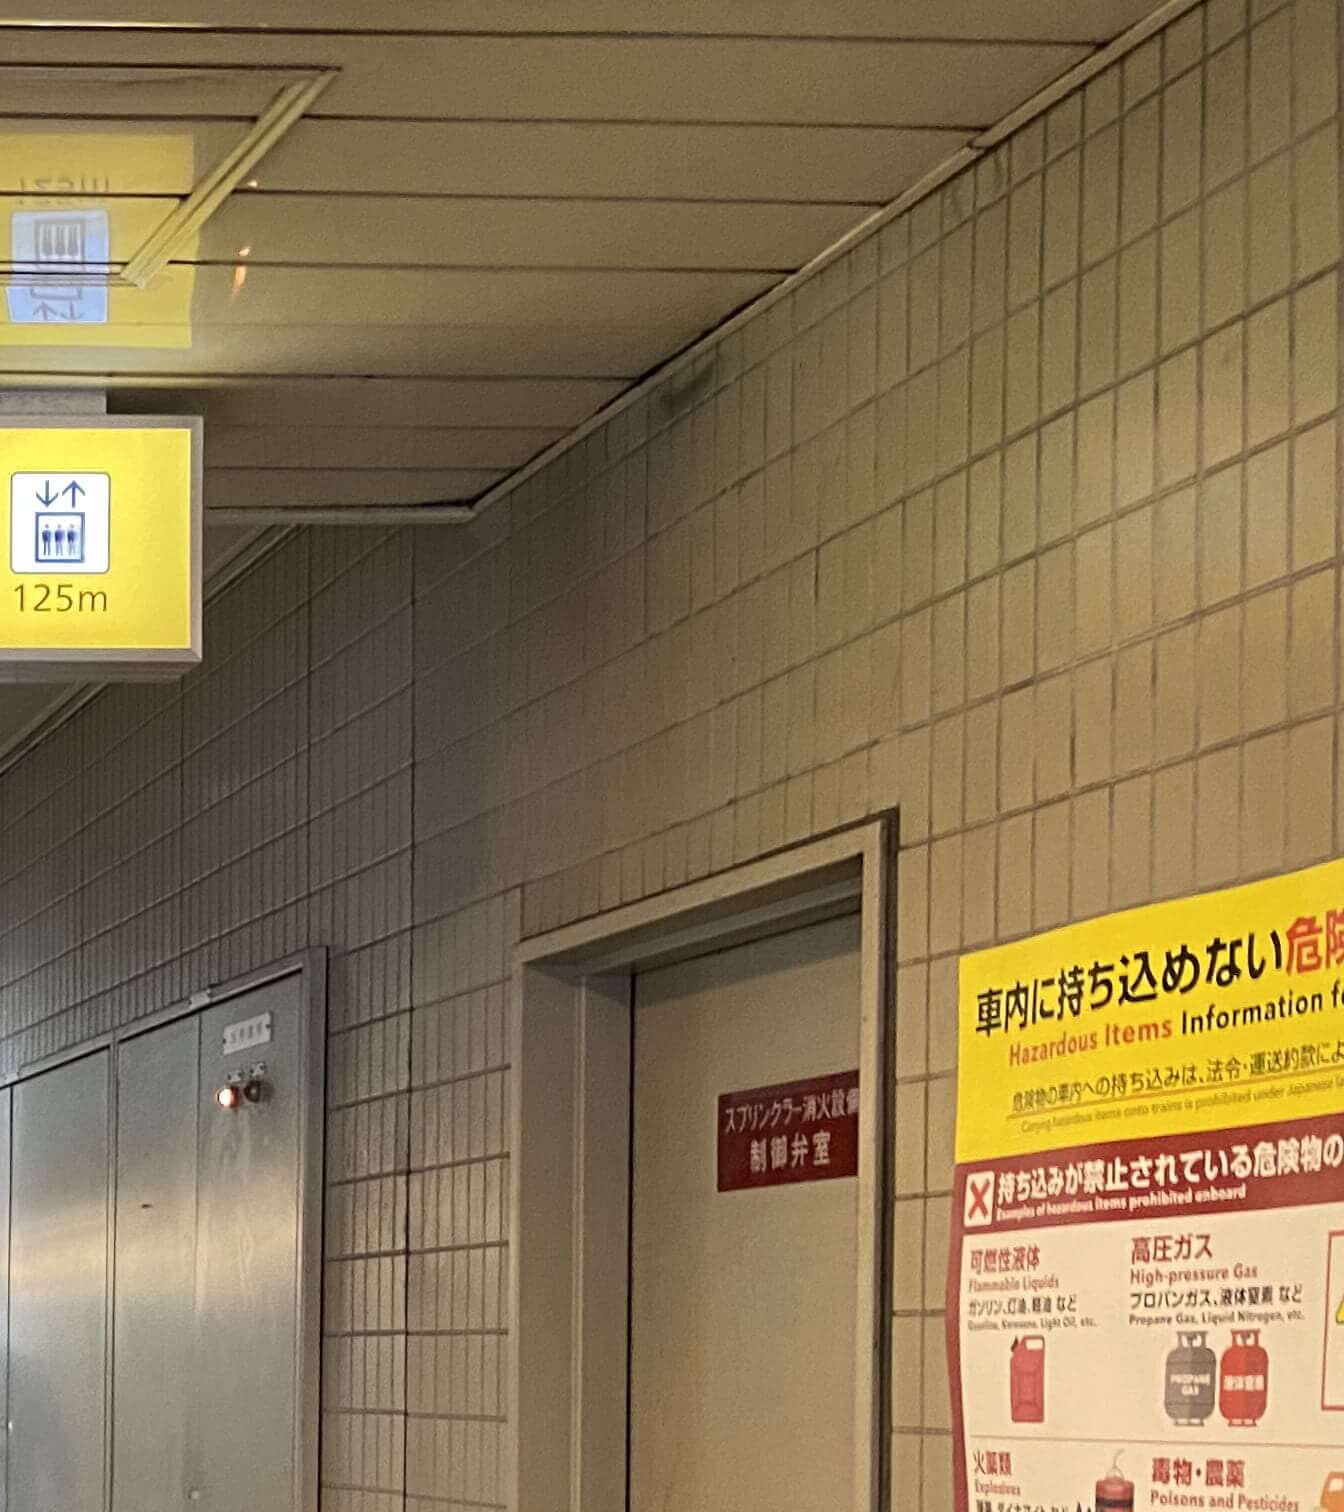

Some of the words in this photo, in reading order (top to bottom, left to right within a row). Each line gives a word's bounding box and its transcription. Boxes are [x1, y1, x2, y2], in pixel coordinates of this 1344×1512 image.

[14, 584, 109, 612] 125m
[1009, 1030, 1098, 1067] Hazardous
[1105, 1018, 1172, 1048] Items
[1181, 986, 1323, 1036] Information
[1130, 1188, 1193, 1211] prohibited
[1131, 1233, 1213, 1265] 高圧ガス
[1130, 1267, 1229, 1288] High-pressure
[1234, 1263, 1258, 1280] Gas
